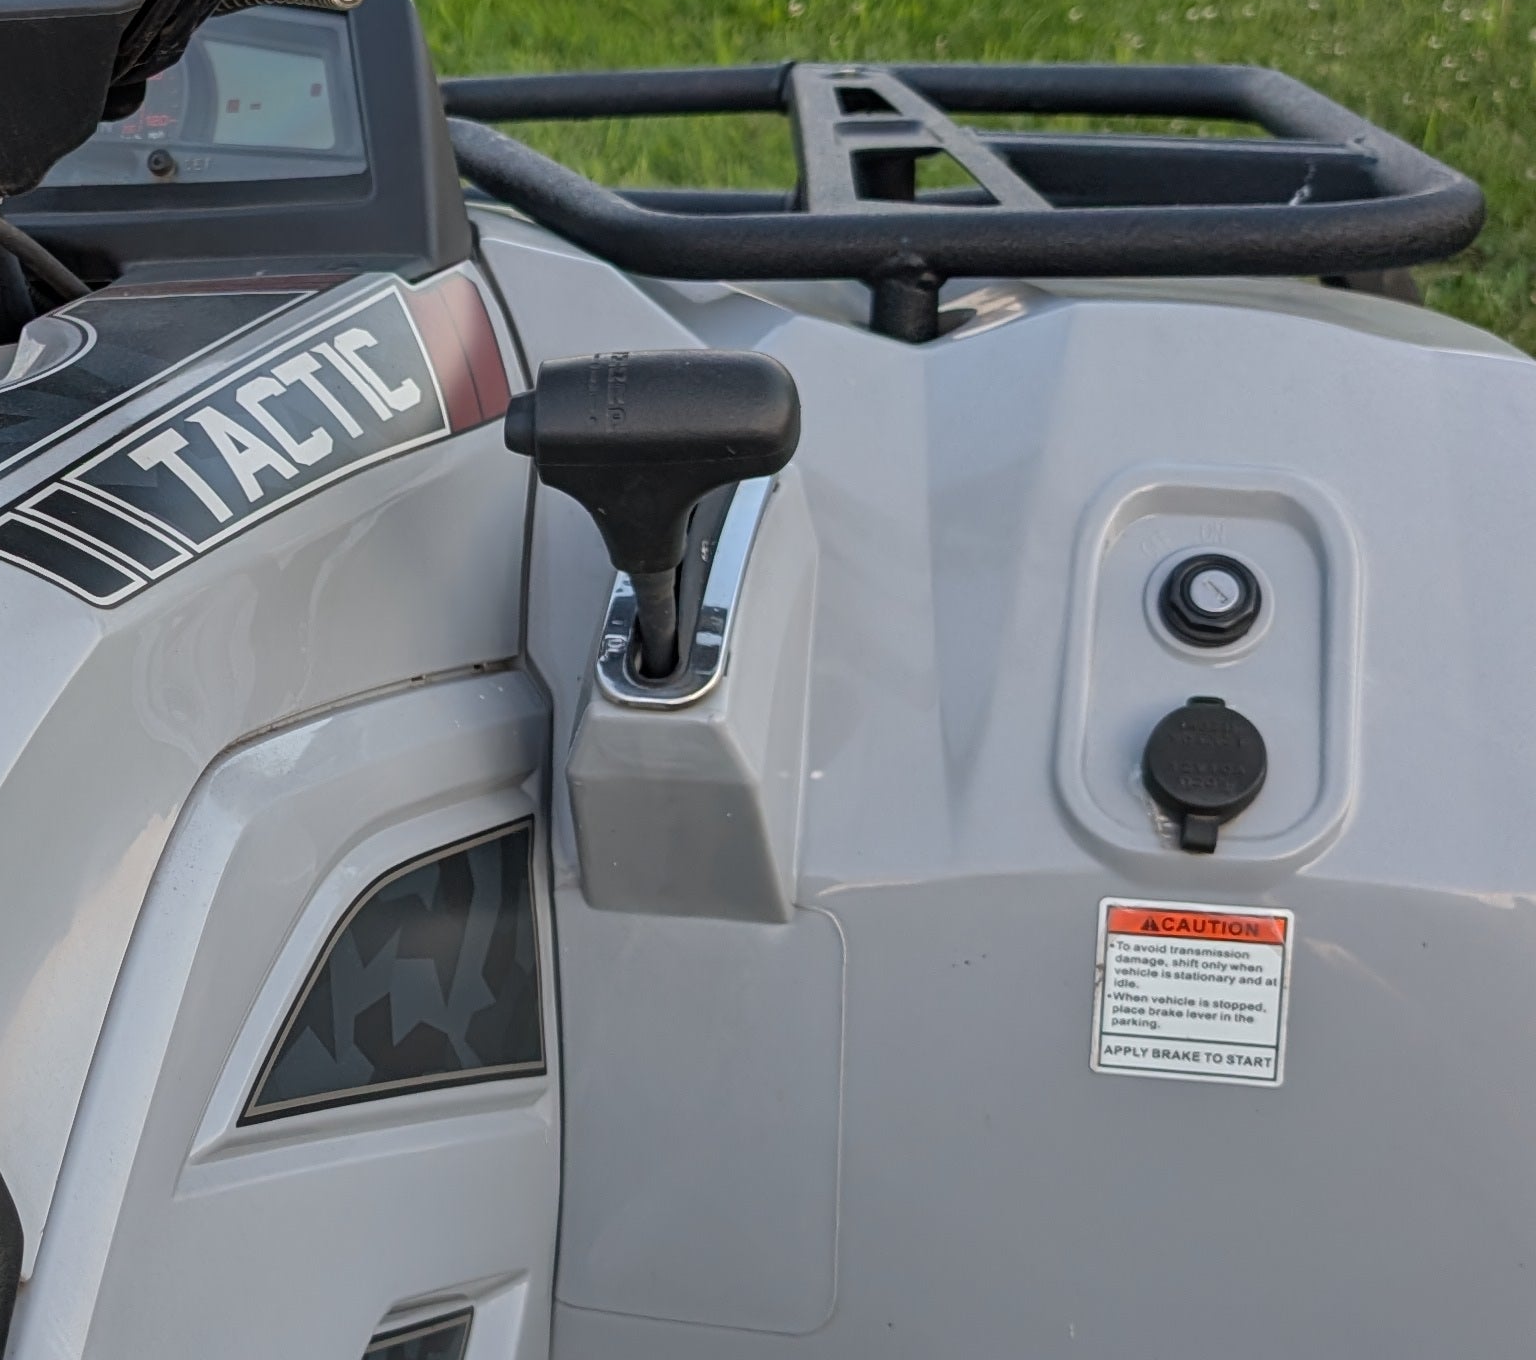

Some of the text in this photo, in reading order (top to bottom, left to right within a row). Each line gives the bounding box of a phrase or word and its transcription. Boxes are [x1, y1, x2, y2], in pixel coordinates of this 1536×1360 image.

[128, 327, 423, 524] TACTIC
[1161, 917, 1260, 937] CAUTION
[1116, 940, 1250, 960] To avoid transmission
[1172, 958, 1199, 969] shift
[1202, 960, 1228, 973] only
[1230, 963, 1263, 973] when
[1114, 966, 1277, 987] vehicle is stationary and at
[1114, 992, 1148, 1003] When
[1151, 994, 1195, 1007] vehicle
[1199, 998, 1209, 1008] is
[1111, 1017, 1161, 1030] parking.
[1112, 1004, 1254, 1024] place brake lever in the
[1103, 1045, 1273, 1068] APPLY BRAKE TO START
